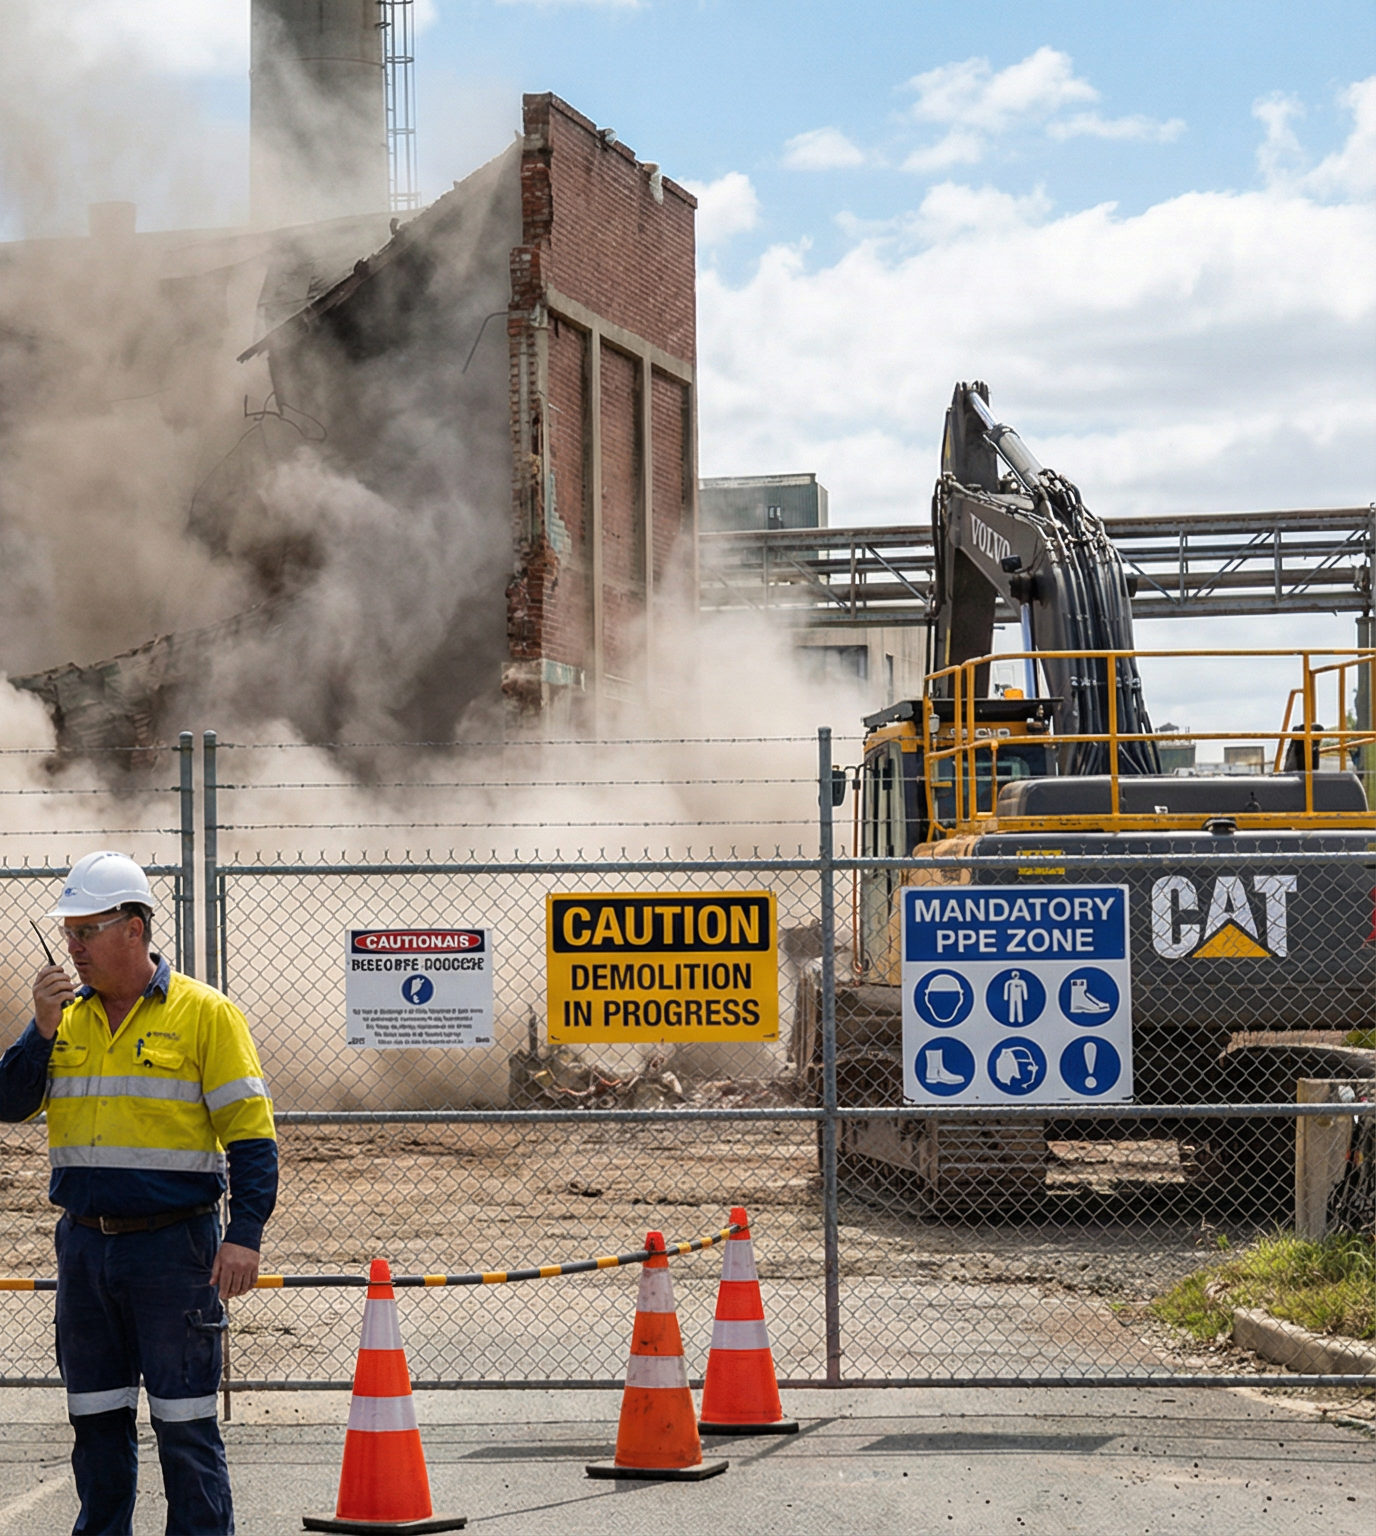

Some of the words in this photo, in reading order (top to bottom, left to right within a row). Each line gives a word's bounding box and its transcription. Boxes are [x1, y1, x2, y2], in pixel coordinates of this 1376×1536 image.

[969, 512, 1011, 564] VOLVO
[914, 896, 1115, 923] MANDATORY
[1151, 874, 1298, 959] CAT
[562, 904, 760, 947] CAUTION
[936, 929, 997, 953] PPE
[1006, 928, 1094, 953] ZONE
[571, 962, 752, 991] DEMOLITION
[564, 1000, 592, 1027] IN
[603, 998, 761, 1027] PROGRESS
